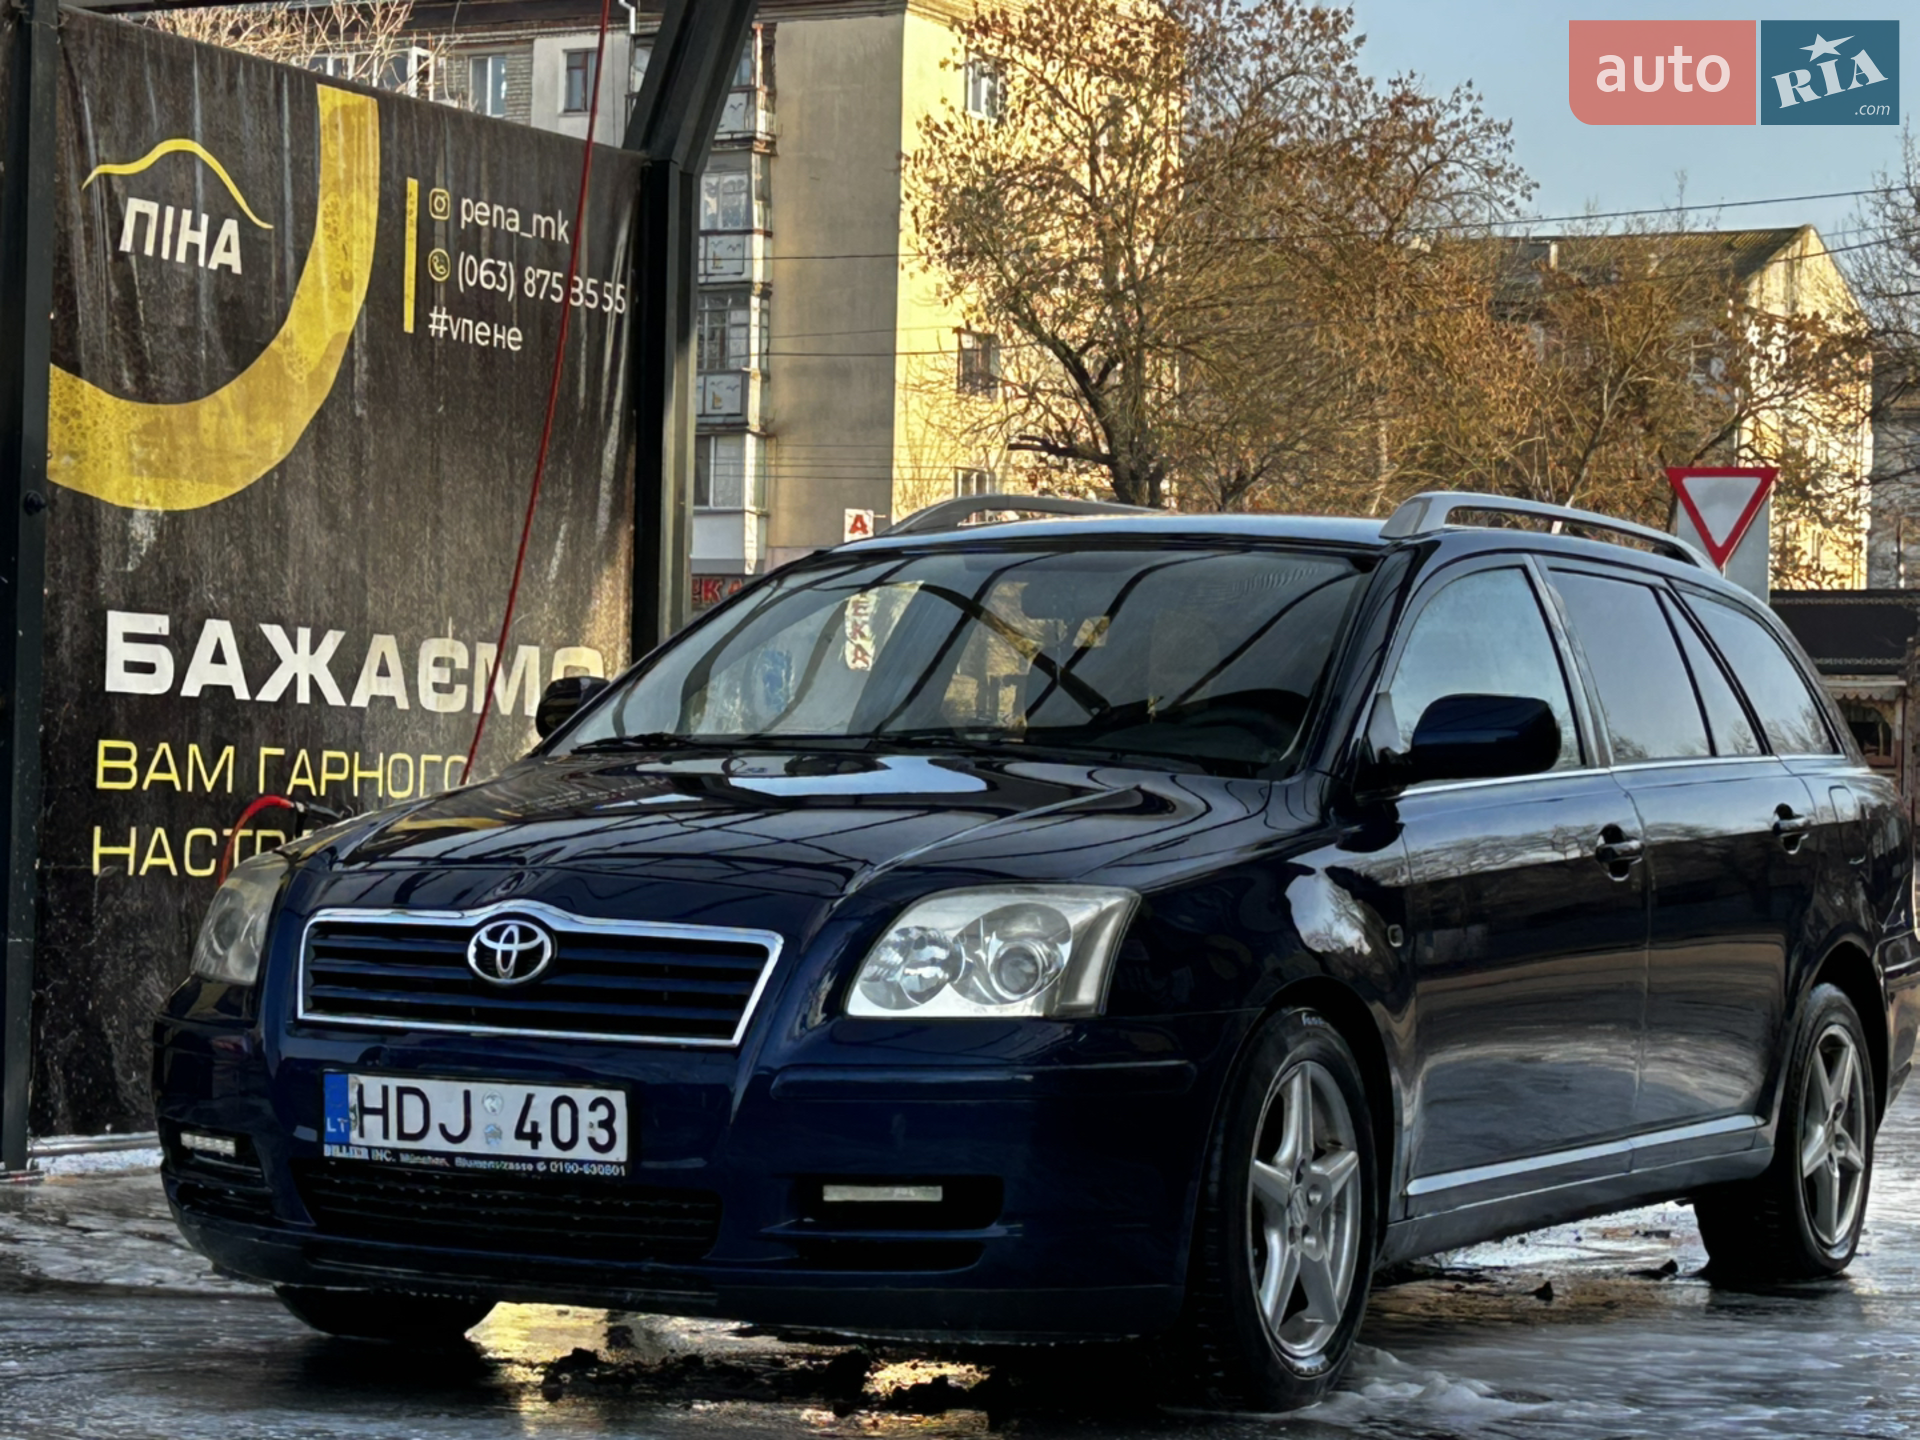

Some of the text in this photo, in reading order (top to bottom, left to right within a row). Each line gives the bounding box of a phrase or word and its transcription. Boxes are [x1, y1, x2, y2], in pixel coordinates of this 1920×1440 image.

[119, 197, 242, 275] ПІНА
[460, 197, 570, 245] pena_mk
[458, 251, 515, 302] (063)
[524, 266, 564, 303] 875
[602, 281, 626, 314] 55
[96, 739, 235, 794] ВАМ
[326, 1117, 349, 1133] LT
[356, 1083, 618, 1154] HDJ 403
